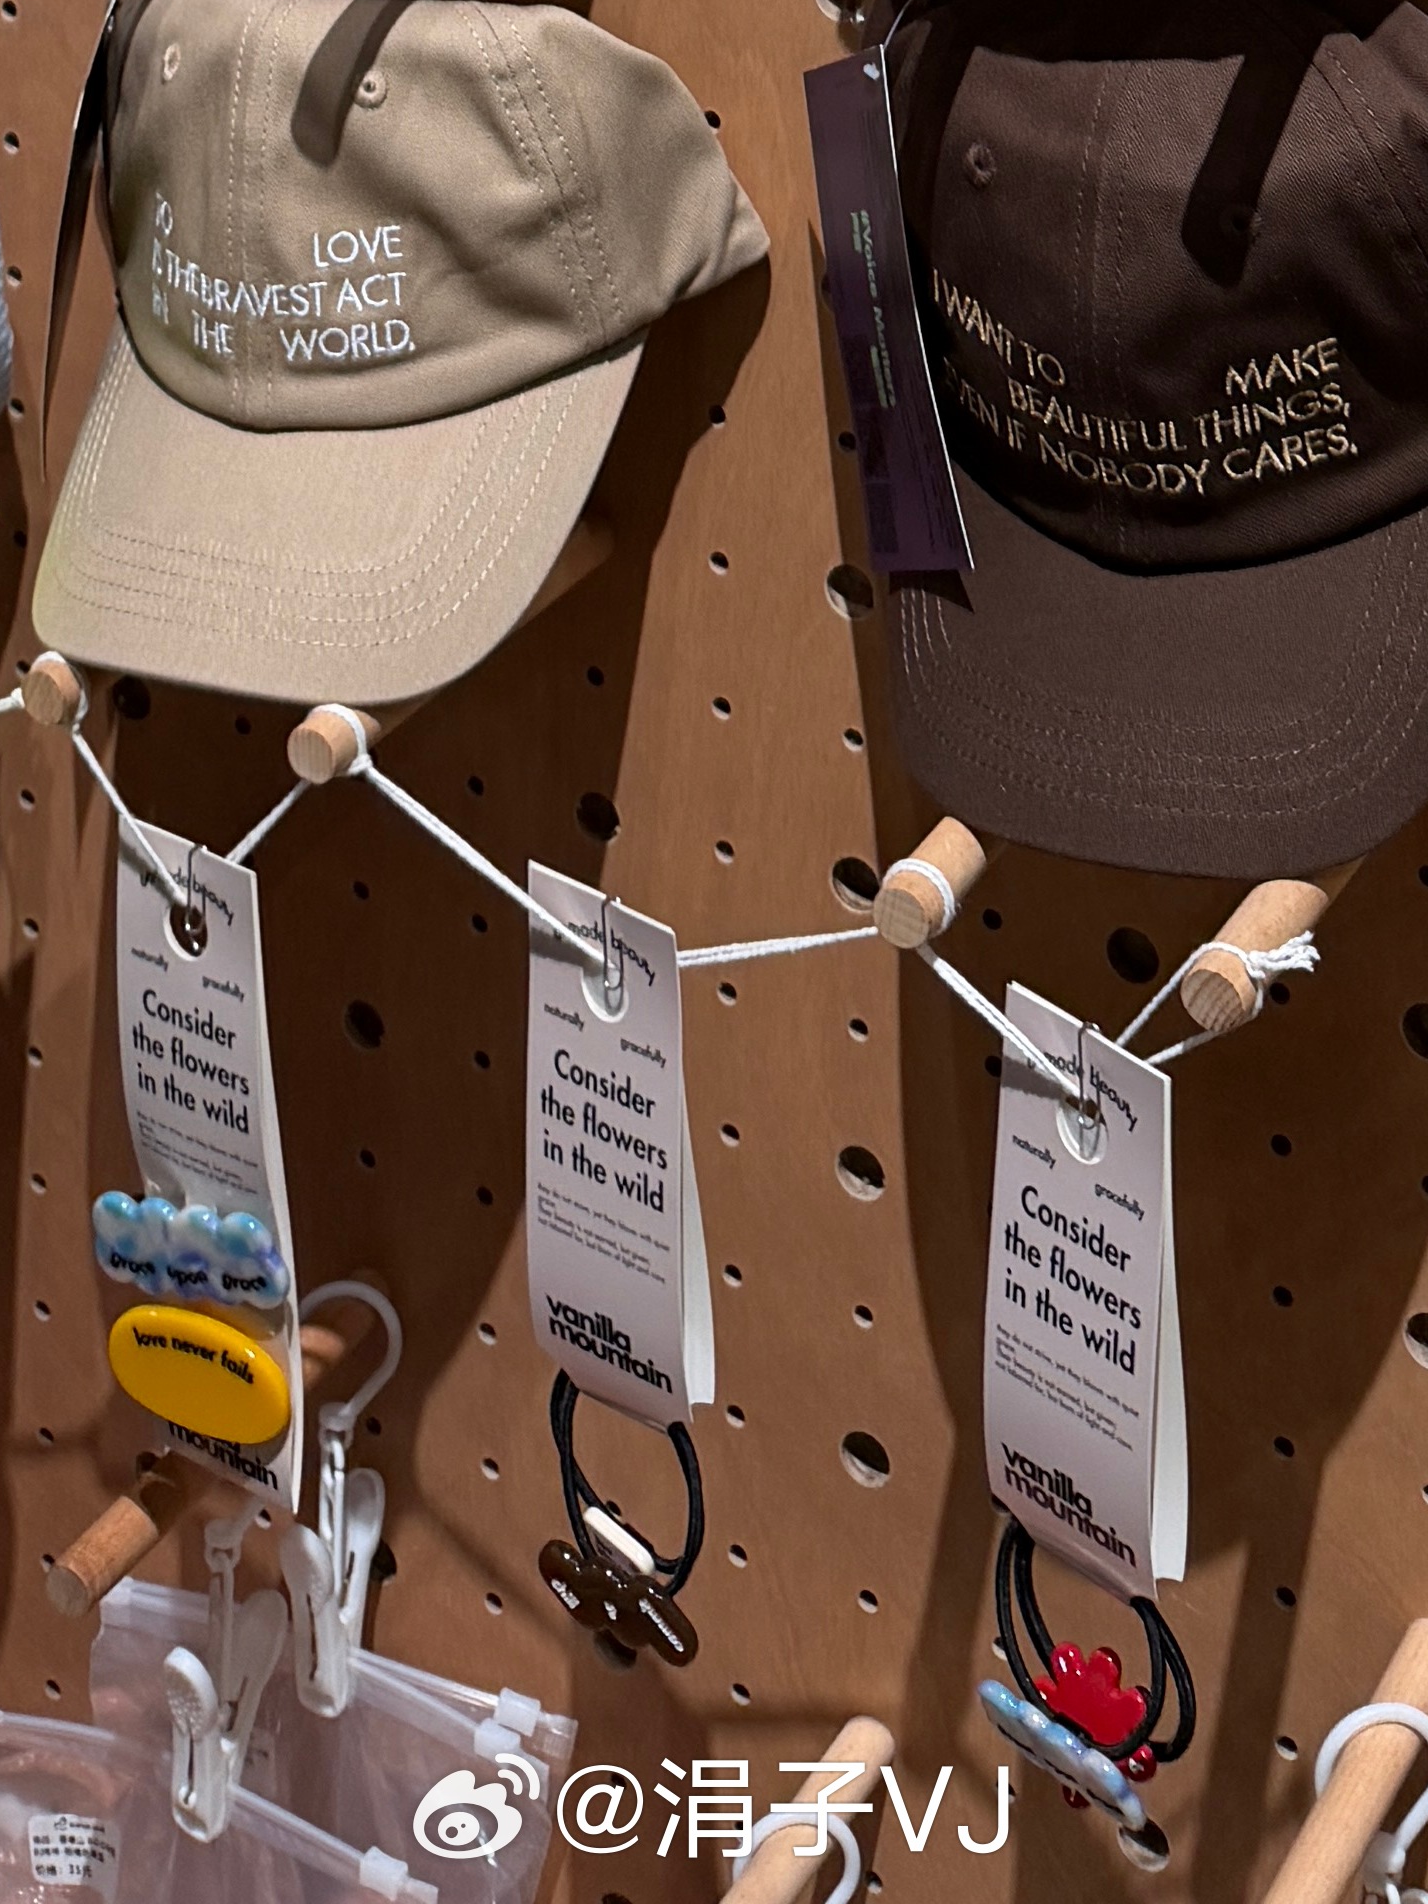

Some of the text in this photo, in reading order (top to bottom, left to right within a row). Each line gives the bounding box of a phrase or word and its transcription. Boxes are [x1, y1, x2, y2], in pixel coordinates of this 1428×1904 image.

[165, 247, 407, 318] THE BRAVEST ACT
[313, 224, 404, 269] LOVE
[191, 308, 416, 362] THE WORLD.
[933, 268, 1339, 396] I WANT TO MAKE
[1007, 377, 1351, 453] BEAUTIFUL THINGS,
[1007, 415, 1358, 496] IF NOBODY CARES.
[142, 988, 237, 1050] Consider
[132, 1020, 251, 1096] the flowers
[554, 1048, 657, 1119] Consider
[137, 1062, 250, 1135] in the wild
[540, 1086, 668, 1171] the flowers
[543, 1129, 665, 1214] in the wild
[1020, 1184, 1132, 1274] Consider
[1004, 1222, 1143, 1331] the flowers
[171, 1334, 218, 1363] never
[220, 1349, 255, 1385] fails
[545, 1292, 633, 1353] vanilla
[549, 1313, 674, 1395] mountain
[1004, 1268, 1136, 1375] in the wild
[168, 1420, 279, 1491] mountain
[1001, 1440, 1094, 1520] vanilla
[1004, 1463, 1138, 1570] mountain
